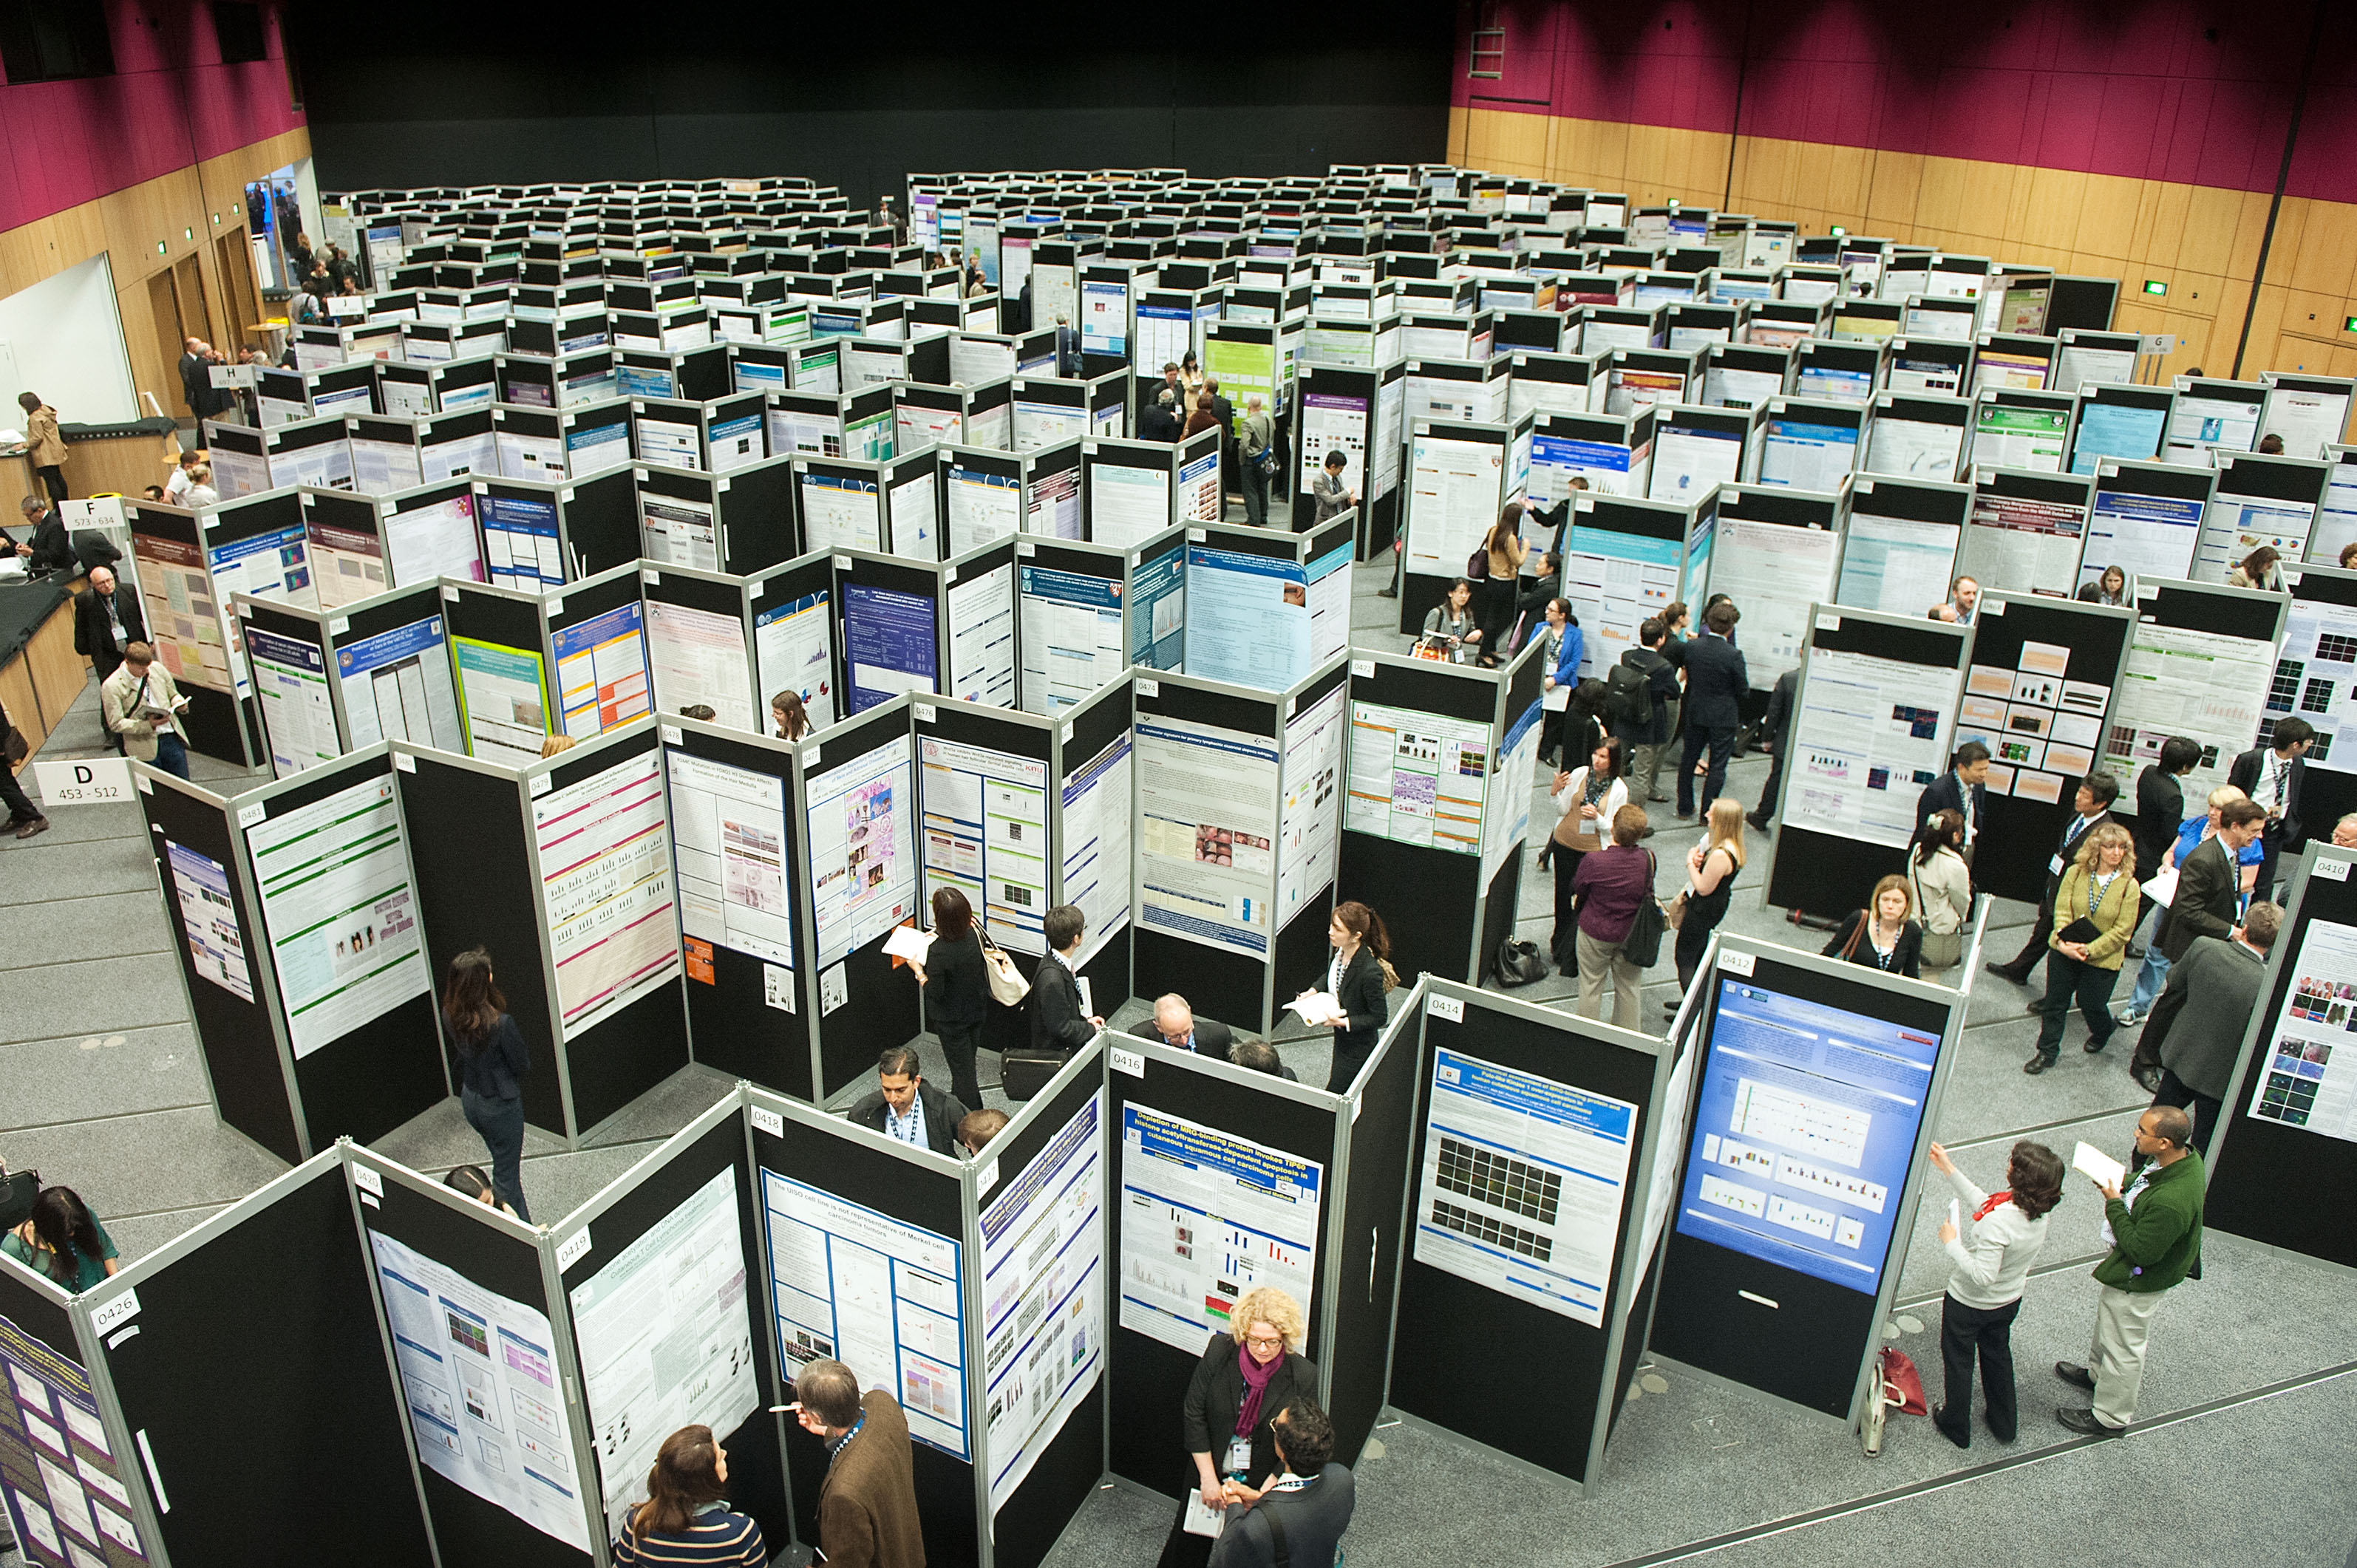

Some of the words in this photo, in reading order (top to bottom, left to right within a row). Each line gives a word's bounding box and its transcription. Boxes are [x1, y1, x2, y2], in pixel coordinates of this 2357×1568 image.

[2155, 337, 2163, 346] G
[227, 368, 236, 378] H
[86, 502, 95, 515] F
[75, 518, 91, 527] 573
[98, 517, 115, 525] 634
[1354, 663, 1372, 673] 0472
[1138, 683, 1156, 692] 0474
[916, 707, 933, 717] 0476
[664, 729, 680, 739] 0478
[803, 751, 818, 763] 0477
[74, 766, 93, 784] D
[531, 780, 549, 791] 0479
[59, 788, 83, 800] 453
[95, 787, 118, 798] 512
[241, 808, 262, 822] 0481
[2318, 862, 2345, 875] 0410
[1723, 954, 1750, 969] 0412
[1432, 1000, 1458, 1014] 0414
[1114, 1054, 1140, 1069] 0416
[754, 1111, 779, 1128] 0418
[1137, 1111, 1169, 1128] Depletion
[1171, 1122, 1179, 1131] of
[1180, 1125, 1227, 1146] MRG-binding
[1228, 1140, 1253, 1155] protein
[1255, 1149, 1282, 1165] invokes
[1285, 1159, 1306, 1172] TIP60
[1135, 1119, 1160, 1134] histone
[1162, 1128, 1261, 1165] acetyltransferase-dependent
[1262, 1159, 1299, 1177] apoptosis
[1301, 1171, 1308, 1180] in
[1148, 1131, 1183, 1148] cutaneous
[1185, 1143, 1222, 1161] squamous
[1222, 1155, 1236, 1166] cell
[1237, 1160, 1273, 1178] carcinoma
[1276, 1172, 1293, 1184] cells
[1155, 1151, 1184, 1166] Introduction
[356, 1169, 378, 1187] 0420
[978, 1166, 996, 1191] 0417
[1239, 1179, 1260, 1192] Materials
[1262, 1187, 1271, 1196] and
[1272, 1190, 1294, 1203] Methods
[774, 1182, 785, 1192] The
[786, 1187, 803, 1199] UISO
[804, 1193, 816, 1203] cell
[817, 1198, 829, 1208] line
[831, 1203, 837, 1211] is
[838, 1206, 849, 1216] not
[851, 1210, 898, 1234] representative
[899, 1229, 906, 1237] of
[908, 1232, 931, 1246] Merkel
[933, 1241, 945, 1252] cell
[828, 1210, 863, 1228] carcinoma
[864, 1224, 886, 1238] tumors
[600, 1258, 621, 1278] Histone
[622, 1234, 650, 1261] acetylation
[650, 1225, 661, 1237] and
[661, 1216, 674, 1229] DNA
[674, 1191, 703, 1219] demethylation
[704, 1184, 714, 1193] in
[610, 1252, 640, 1280] Cutaneous
[645, 1239, 656, 1252] Cell
[656, 1217, 684, 1242] Lymphoma
[684, 1196, 708, 1220] treatment
[561, 1235, 587, 1262] 0419
[98, 1297, 132, 1325] 0426
